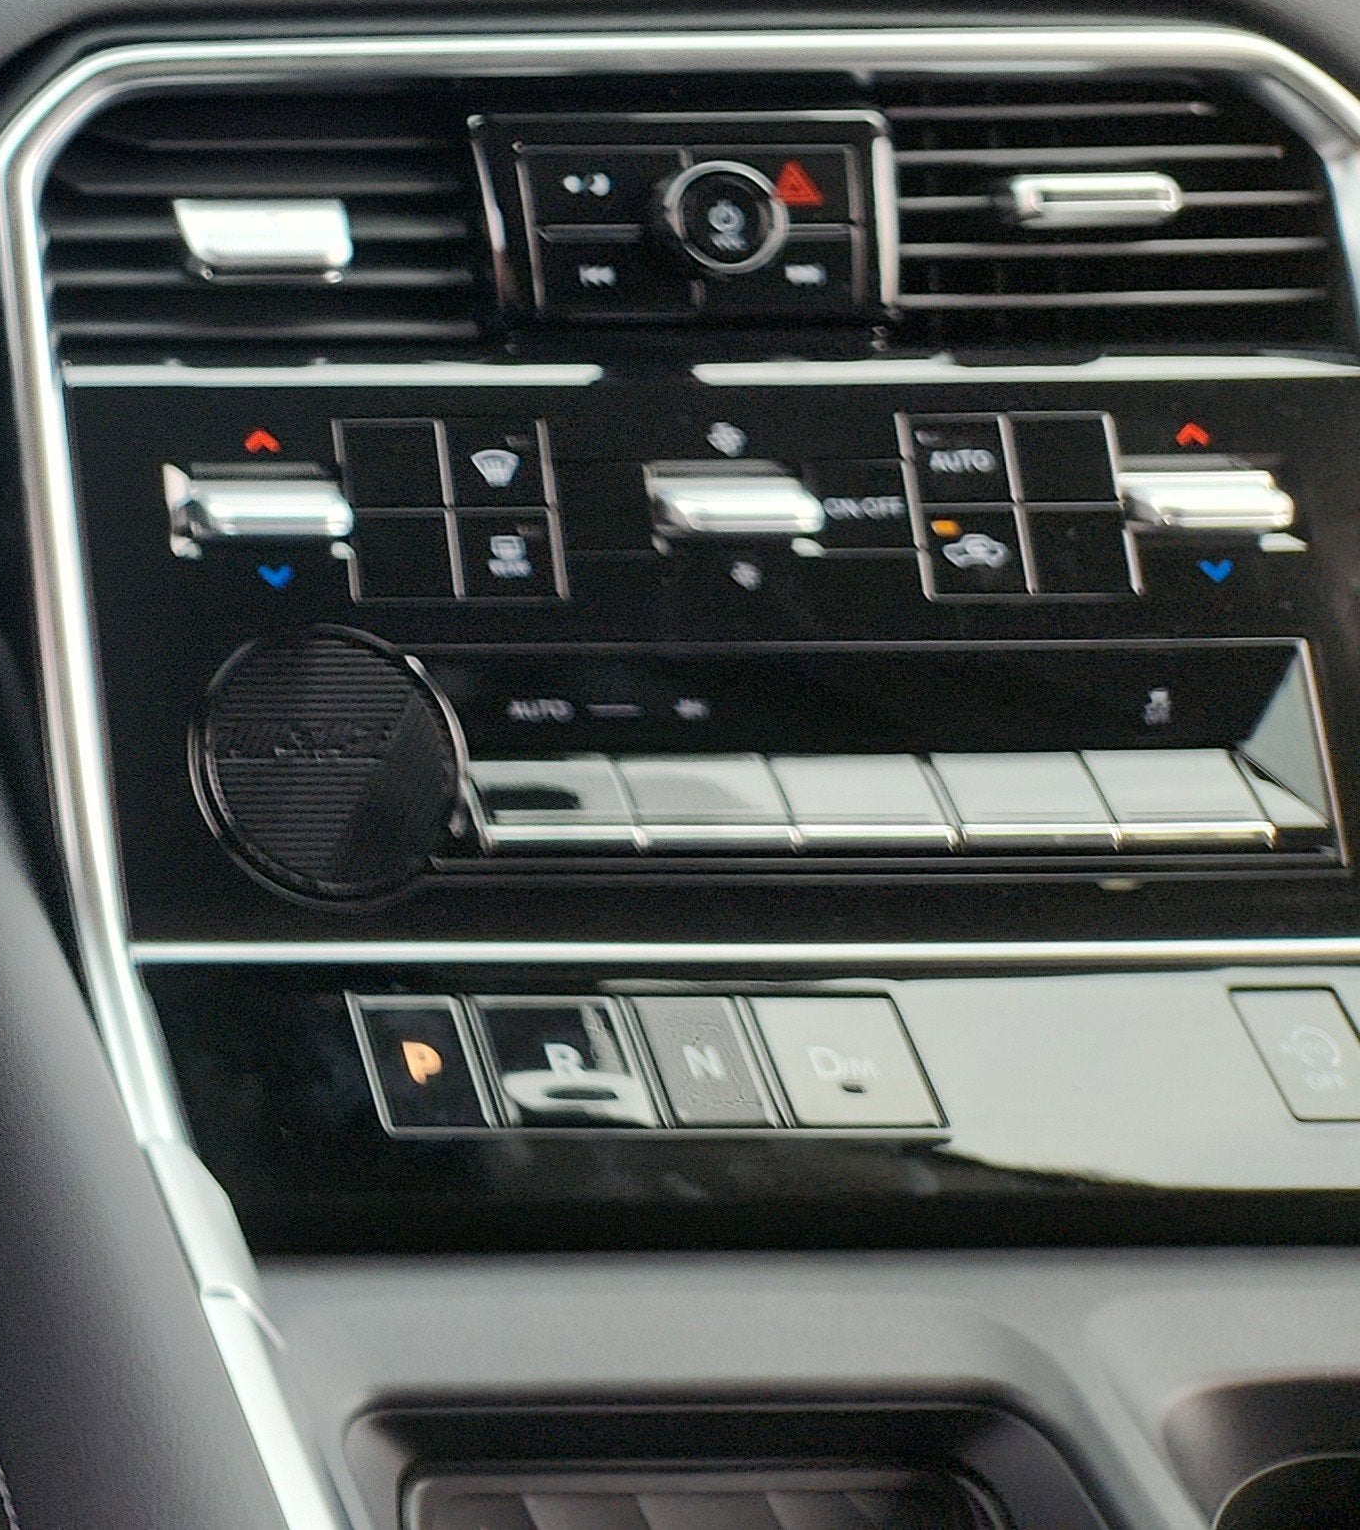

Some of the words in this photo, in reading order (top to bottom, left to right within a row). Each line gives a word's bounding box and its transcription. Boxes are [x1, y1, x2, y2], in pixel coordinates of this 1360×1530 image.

[929, 449, 996, 473] AUTO
[401, 1041, 442, 1085] P
[681, 1045, 723, 1079] N
